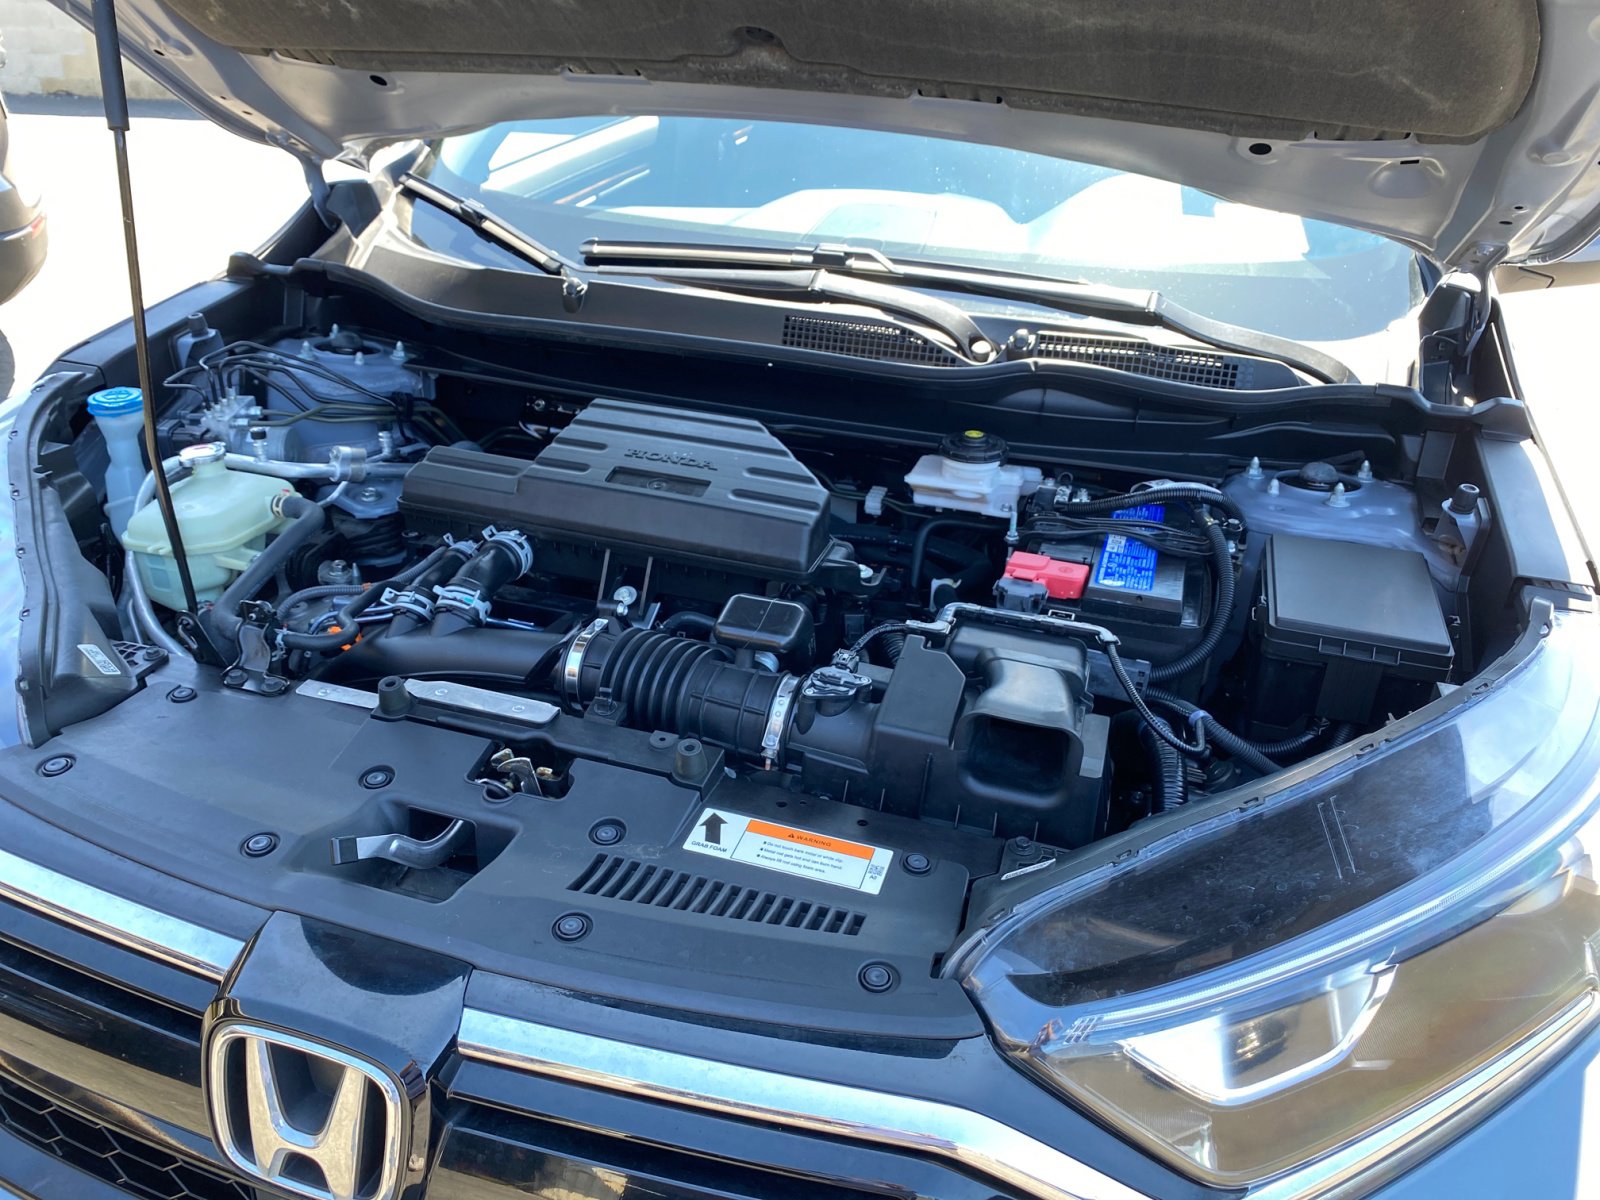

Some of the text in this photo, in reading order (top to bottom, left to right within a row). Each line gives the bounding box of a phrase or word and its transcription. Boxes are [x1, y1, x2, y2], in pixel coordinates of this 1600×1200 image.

[624, 448, 718, 471] HONDA
[691, 840, 727, 853] GRAB FOAM
[796, 835, 832, 847] WARNING
